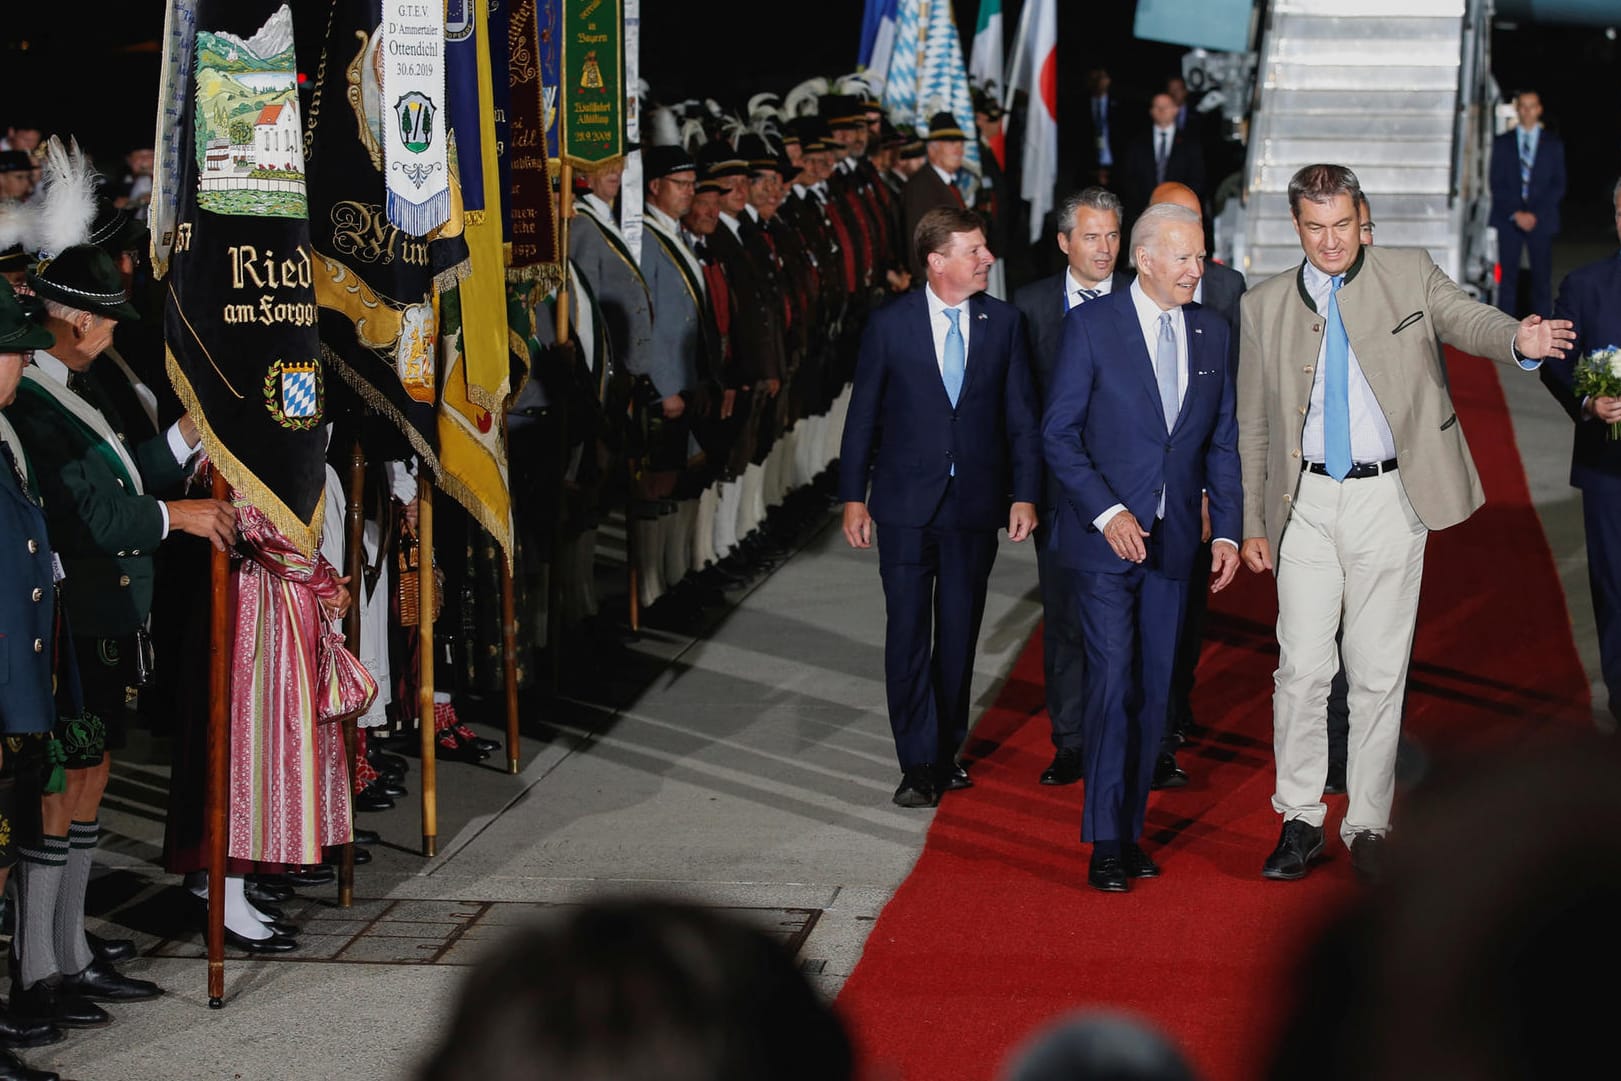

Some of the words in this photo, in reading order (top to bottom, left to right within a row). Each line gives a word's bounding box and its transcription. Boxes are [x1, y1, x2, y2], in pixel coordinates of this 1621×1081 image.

[398, 4, 430, 18] G.T.E.V.
[388, 39, 438, 57] Ottendichl
[396, 62, 434, 77] 30.6.2019
[227, 244, 313, 289] Ried
[223, 303, 258, 325] am
